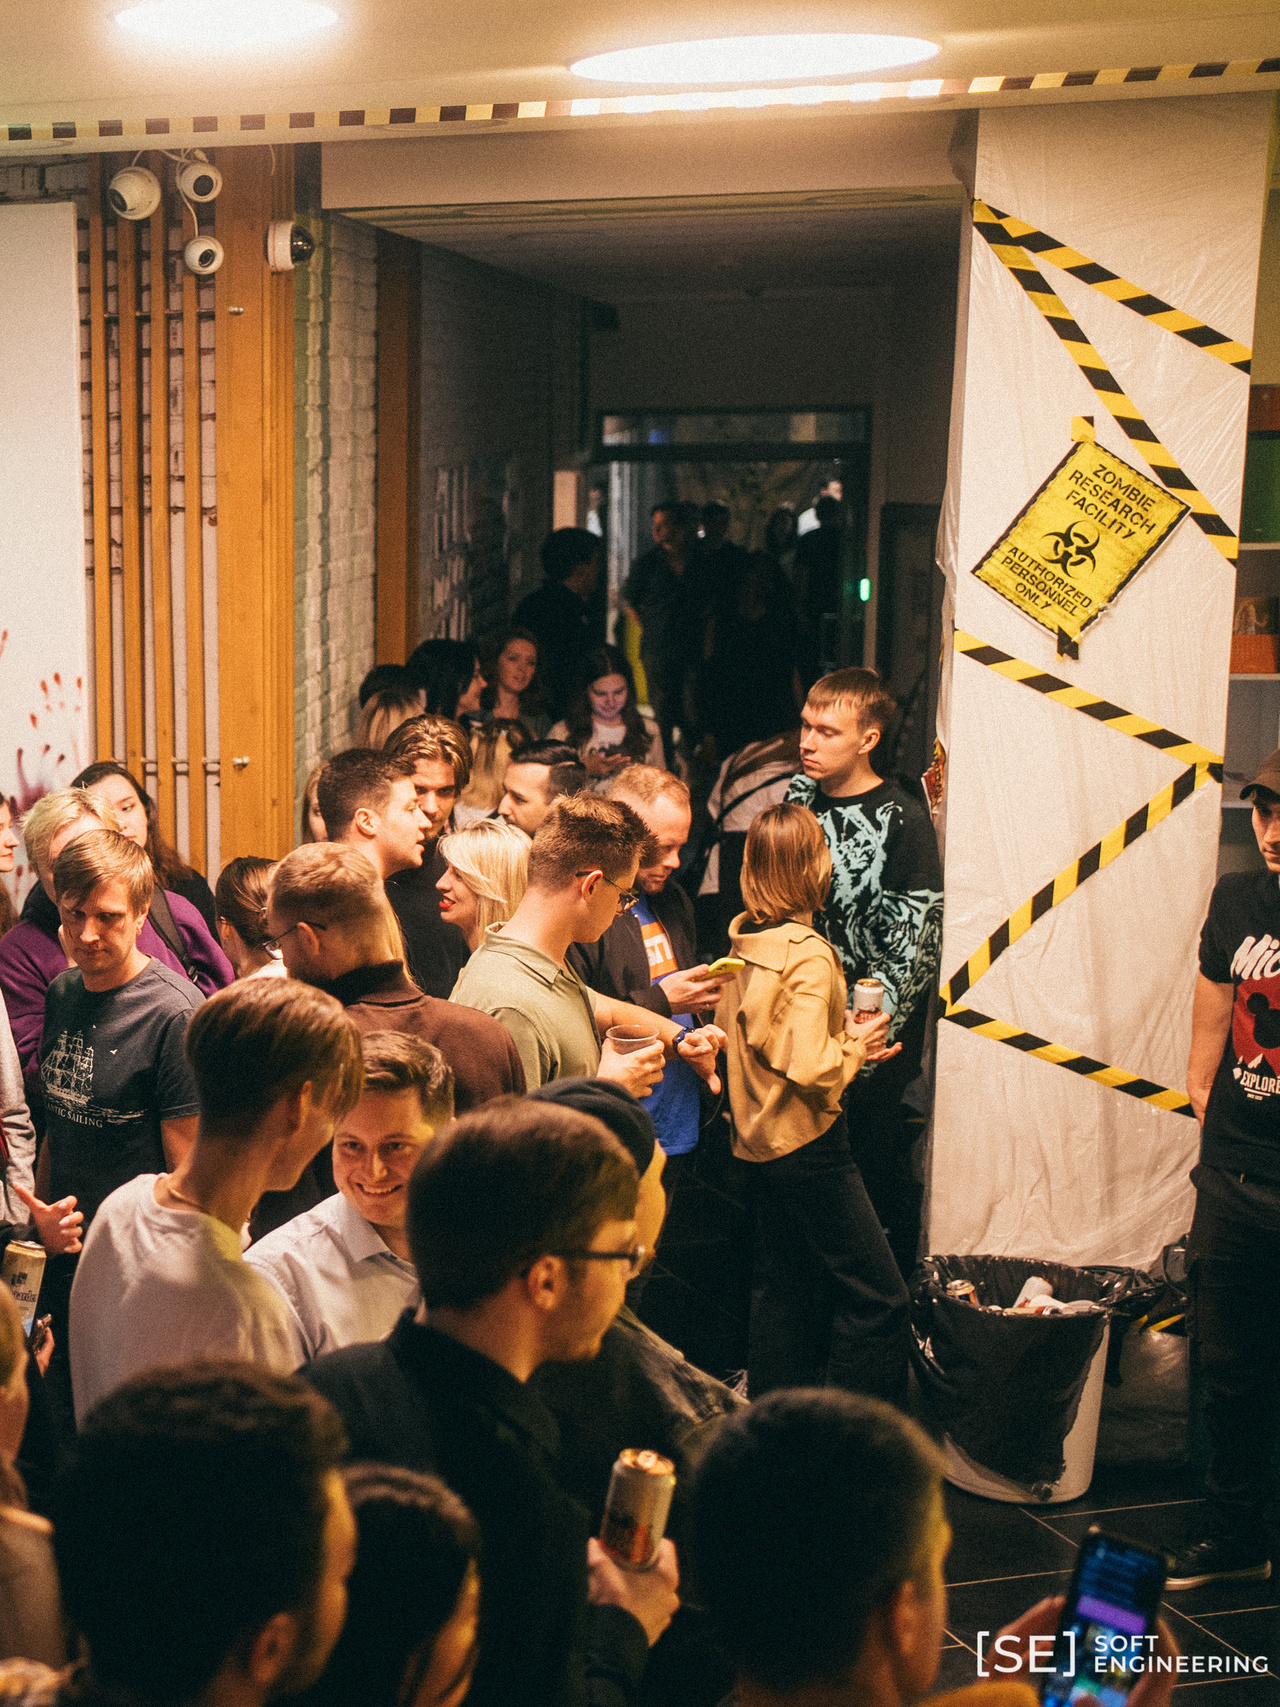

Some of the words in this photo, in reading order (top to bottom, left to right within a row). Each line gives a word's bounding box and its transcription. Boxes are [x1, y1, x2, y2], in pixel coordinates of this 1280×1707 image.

[1068, 469, 1157, 535] RESEARCH
[1092, 463, 1156, 513] ZOMBIE
[1065, 489, 1136, 540] FACILITY
[1001, 556, 1076, 617] PERSONNEL
[1008, 546, 1092, 609] AUTHORIZED
[1015, 582, 1052, 610] ONLY
[67, 1110, 104, 1128] SAILING
